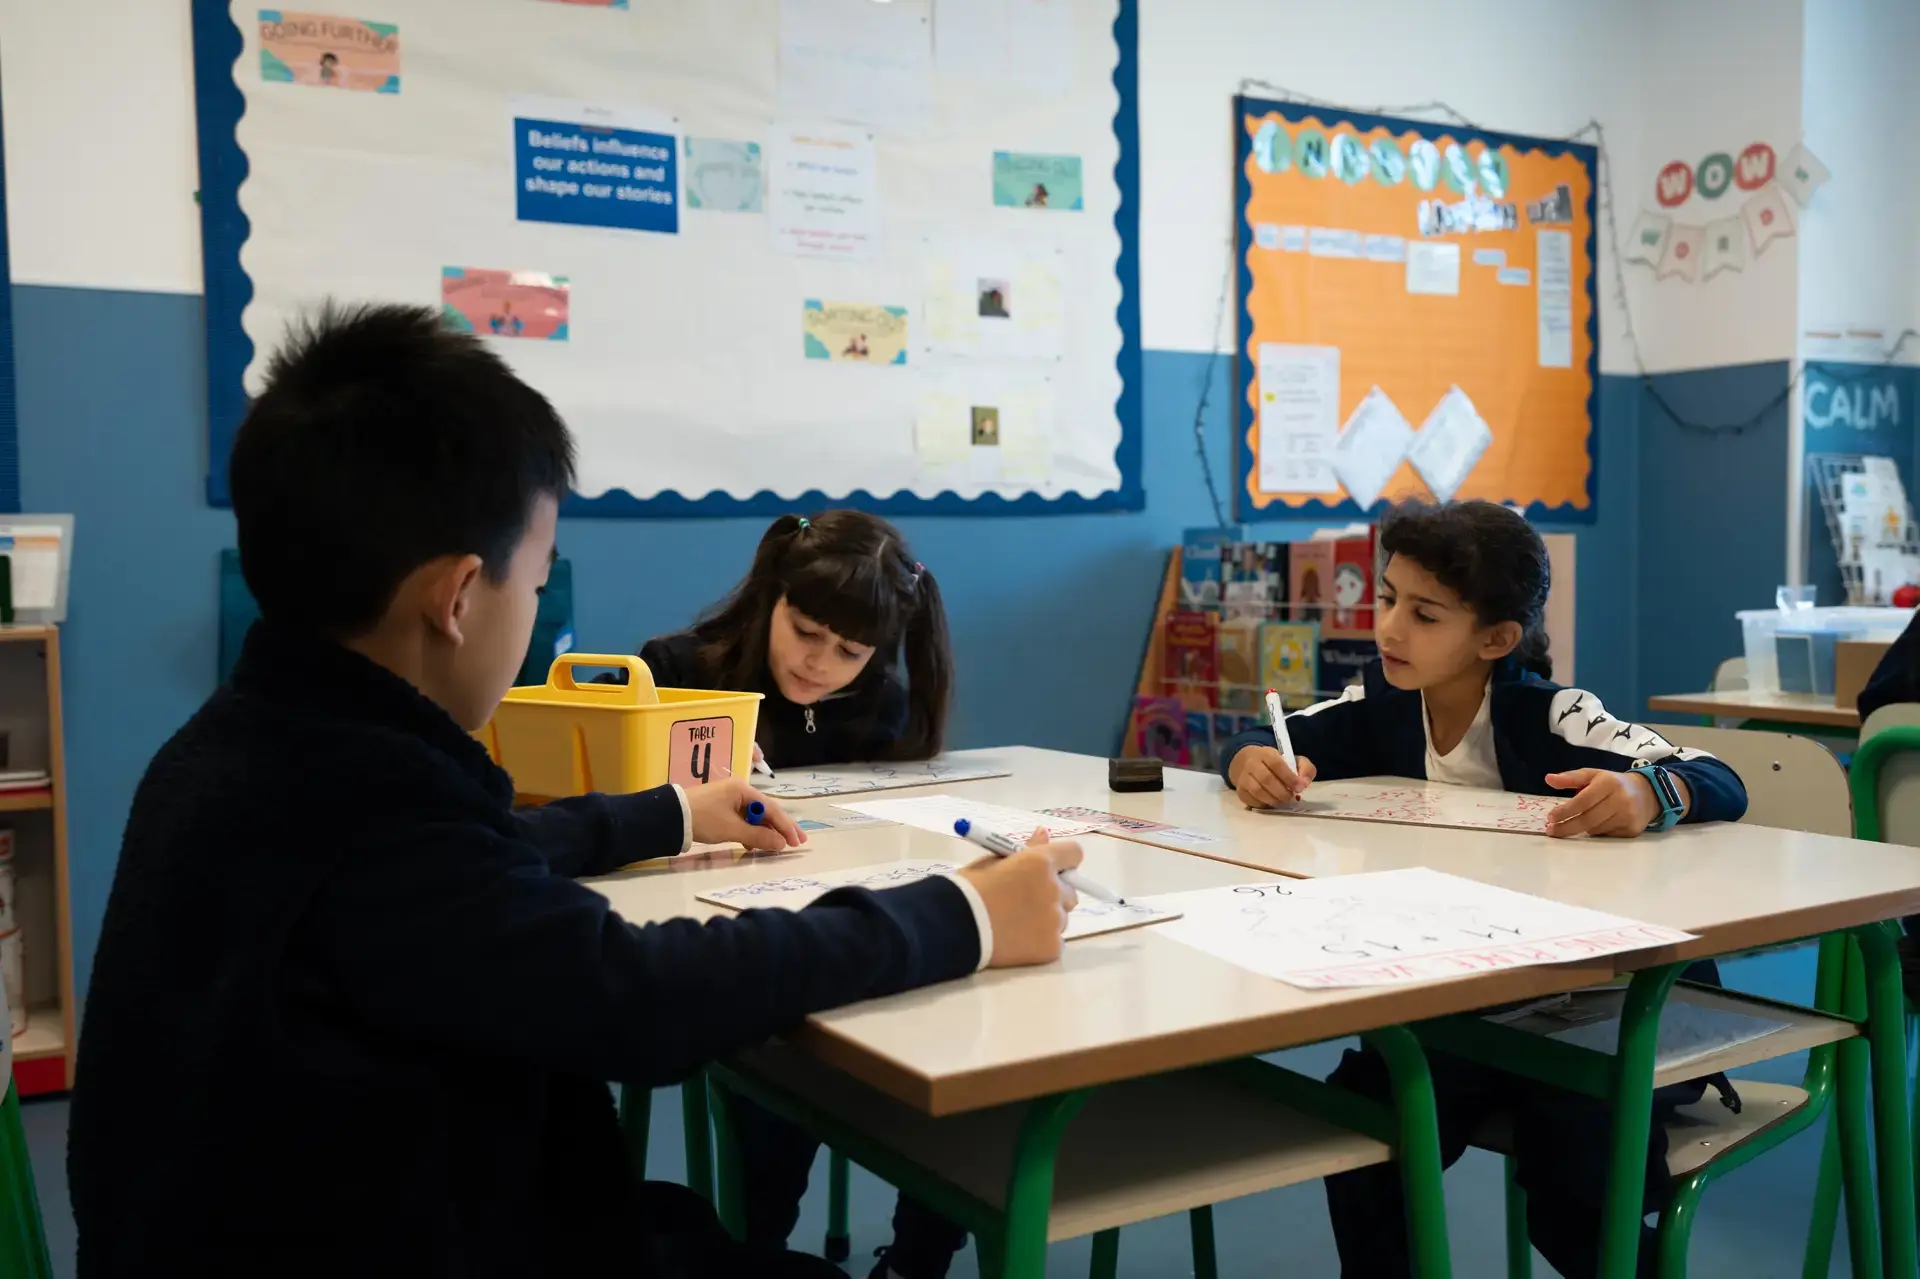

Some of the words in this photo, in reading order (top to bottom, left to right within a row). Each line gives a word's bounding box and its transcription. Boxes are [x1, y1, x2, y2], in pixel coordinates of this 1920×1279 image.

[261, 21, 317, 41] GOING
[528, 129, 589, 153] Beliefs
[592, 137, 670, 162] influence
[532, 155, 564, 172] our
[567, 158, 631, 179] actions
[633, 165, 665, 183] and
[1658, 149, 1773, 202] WOW
[525, 175, 579, 198] shape
[582, 182, 613, 199] our
[616, 185, 674, 206] stories
[1803, 382, 1900, 430] CALM
[688, 725, 717, 742] TABLE
[690, 742, 712, 785] 4
[1232, 883, 1294, 898] 26
